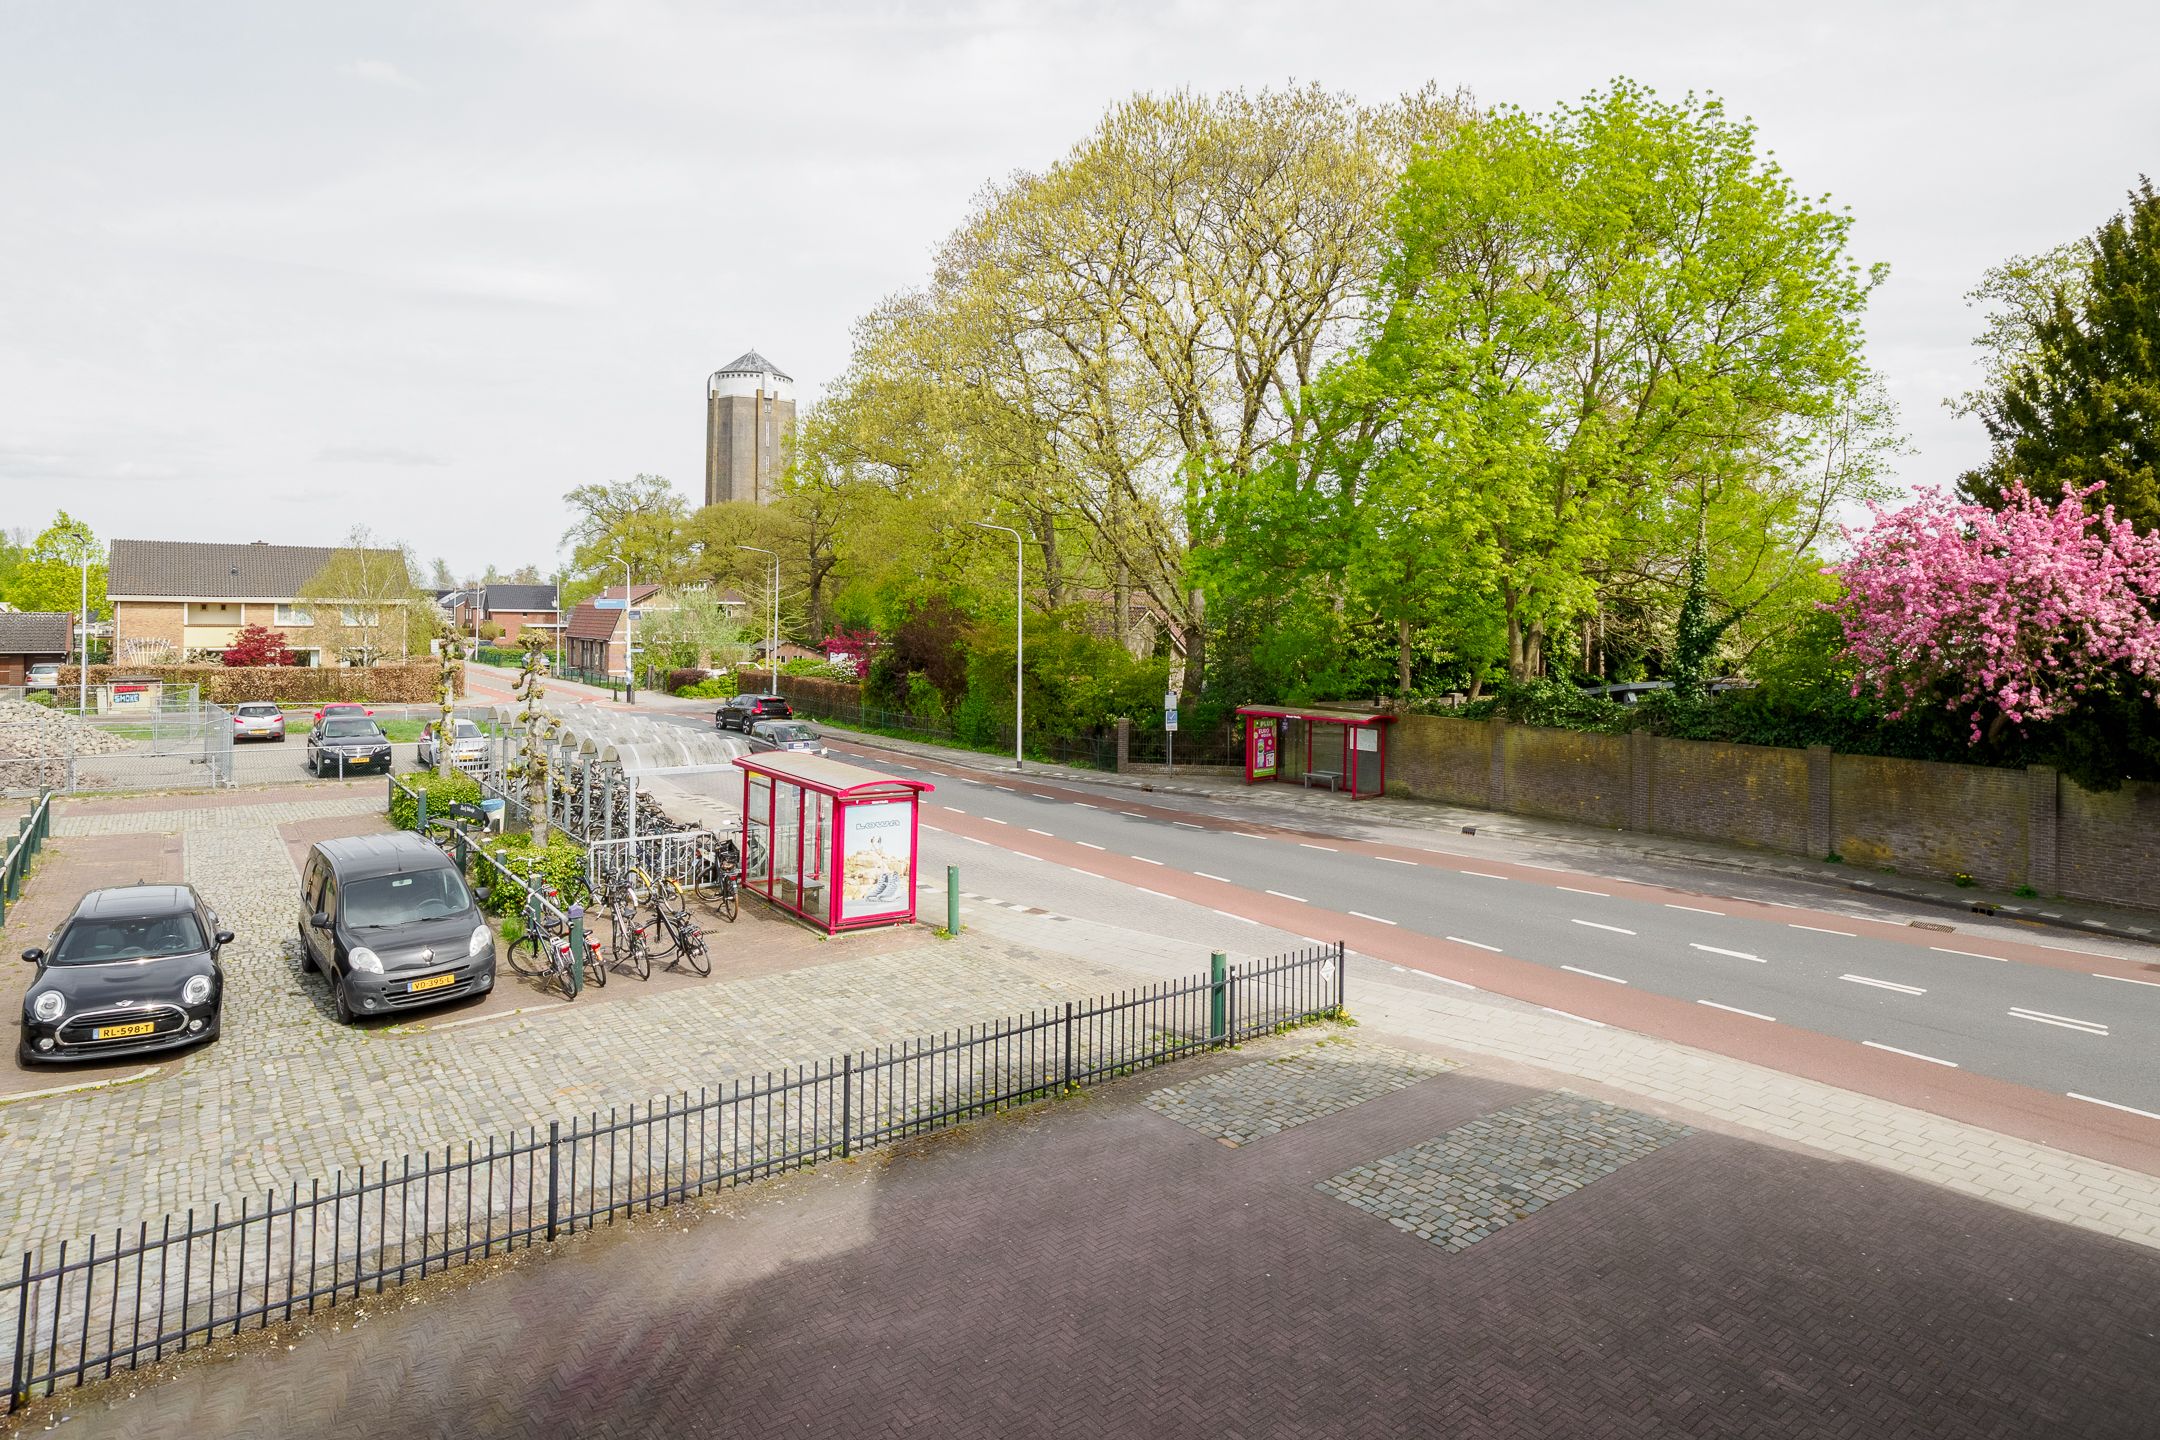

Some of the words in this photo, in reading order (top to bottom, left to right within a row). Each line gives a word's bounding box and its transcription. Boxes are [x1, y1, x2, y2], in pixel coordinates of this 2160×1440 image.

[114, 694, 139, 703] SMOKE
[1260, 720, 1273, 728] PLUS
[856, 820, 900, 830] LOWA
[414, 976, 452, 989] VD-395-L
[103, 1024, 150, 1037] RL-598-T
